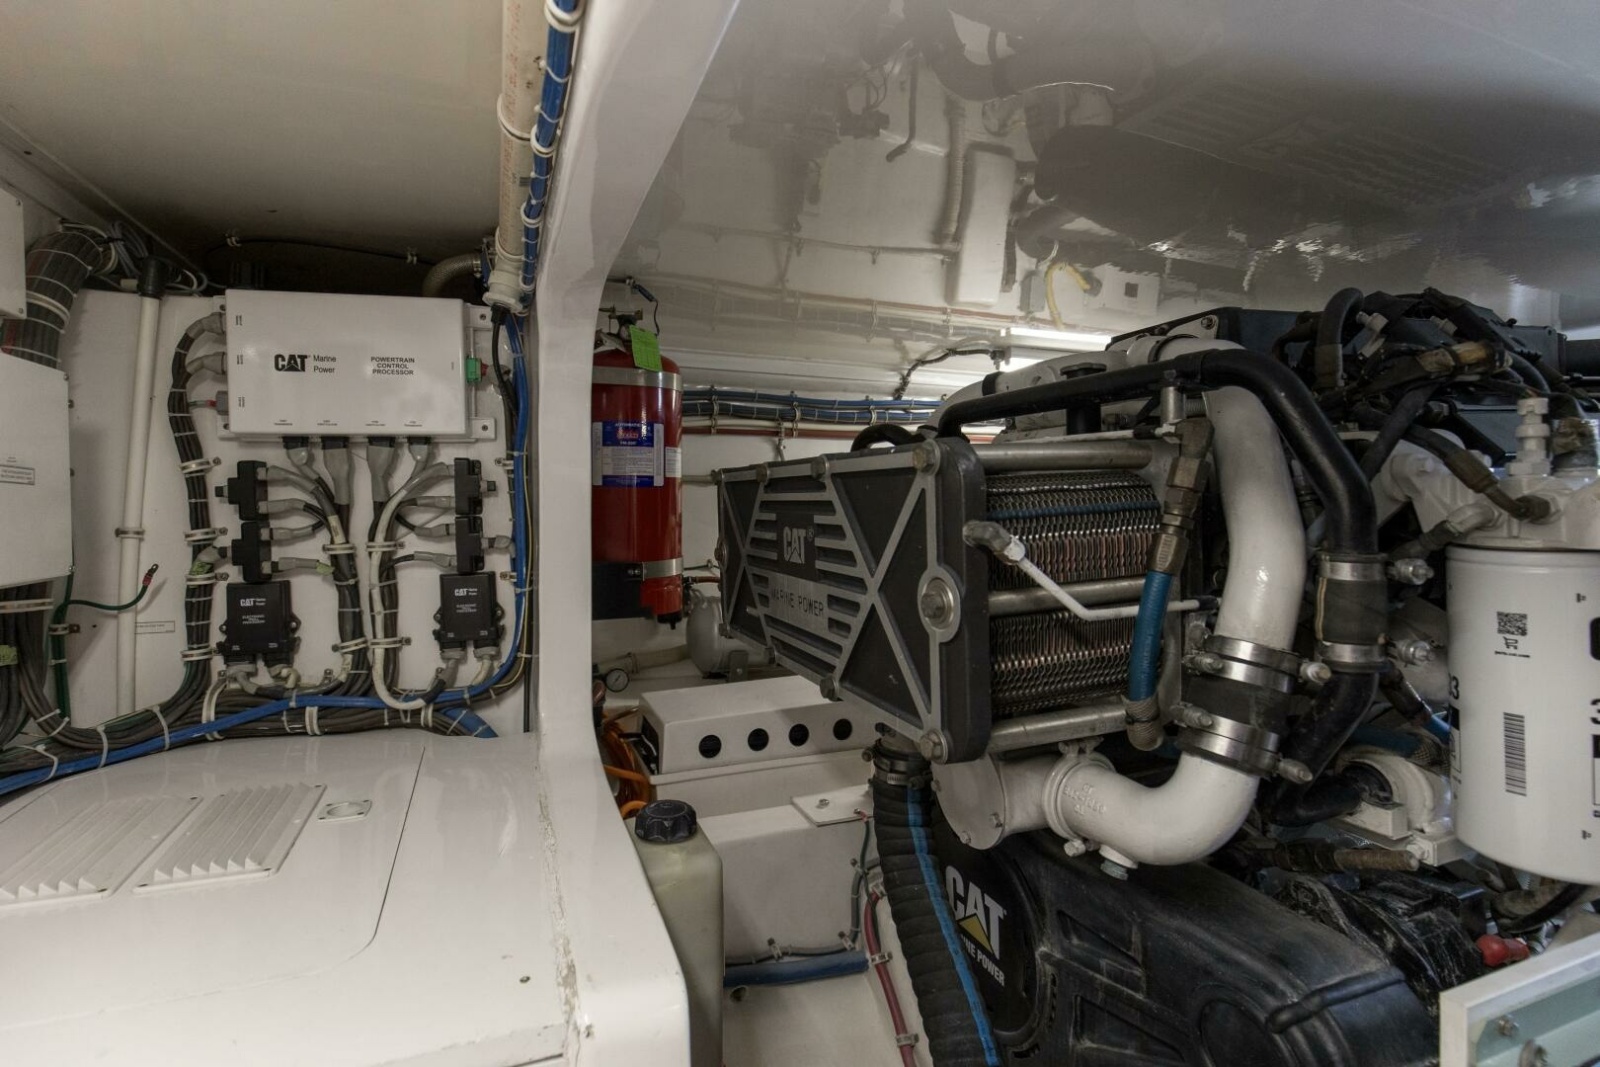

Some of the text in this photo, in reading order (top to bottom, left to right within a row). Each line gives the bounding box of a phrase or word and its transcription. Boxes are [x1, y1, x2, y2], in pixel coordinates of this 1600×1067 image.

[274, 354, 308, 372] CAT
[313, 355, 337, 363] Marine
[783, 526, 807, 564] CAT
[240, 598, 255, 607] CAT
[454, 588, 467, 597] CAT
[797, 595, 824, 617] POWER
[945, 865, 1005, 960] CAT
[977, 948, 1006, 987] POWER
